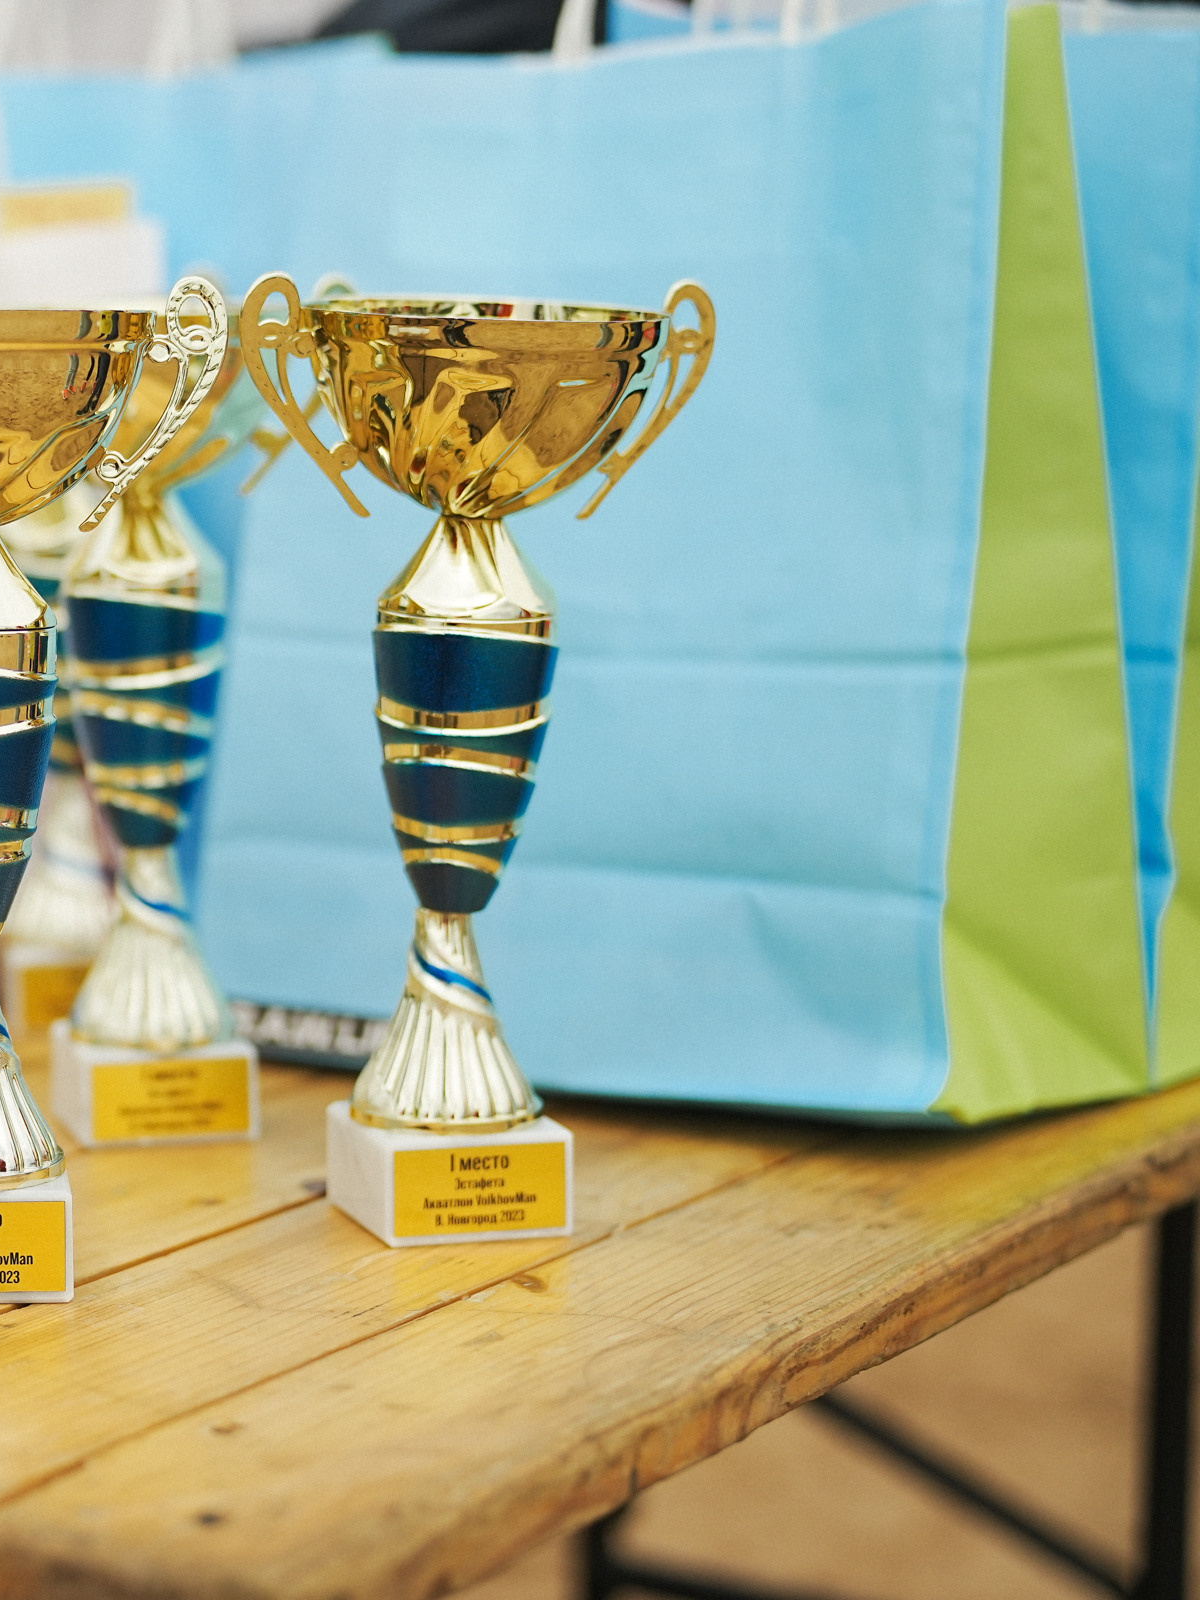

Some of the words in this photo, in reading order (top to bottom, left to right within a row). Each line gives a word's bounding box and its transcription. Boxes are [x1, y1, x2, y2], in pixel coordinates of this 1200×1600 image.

[459, 1155, 509, 1171] место
[454, 1177, 505, 1190] Эстафета
[423, 1198, 473, 1209] Акватлон
[475, 1192, 537, 1206] VolkhovMan
[447, 1211, 497, 1225] Новгород
[500, 1209, 525, 1222] 2023
